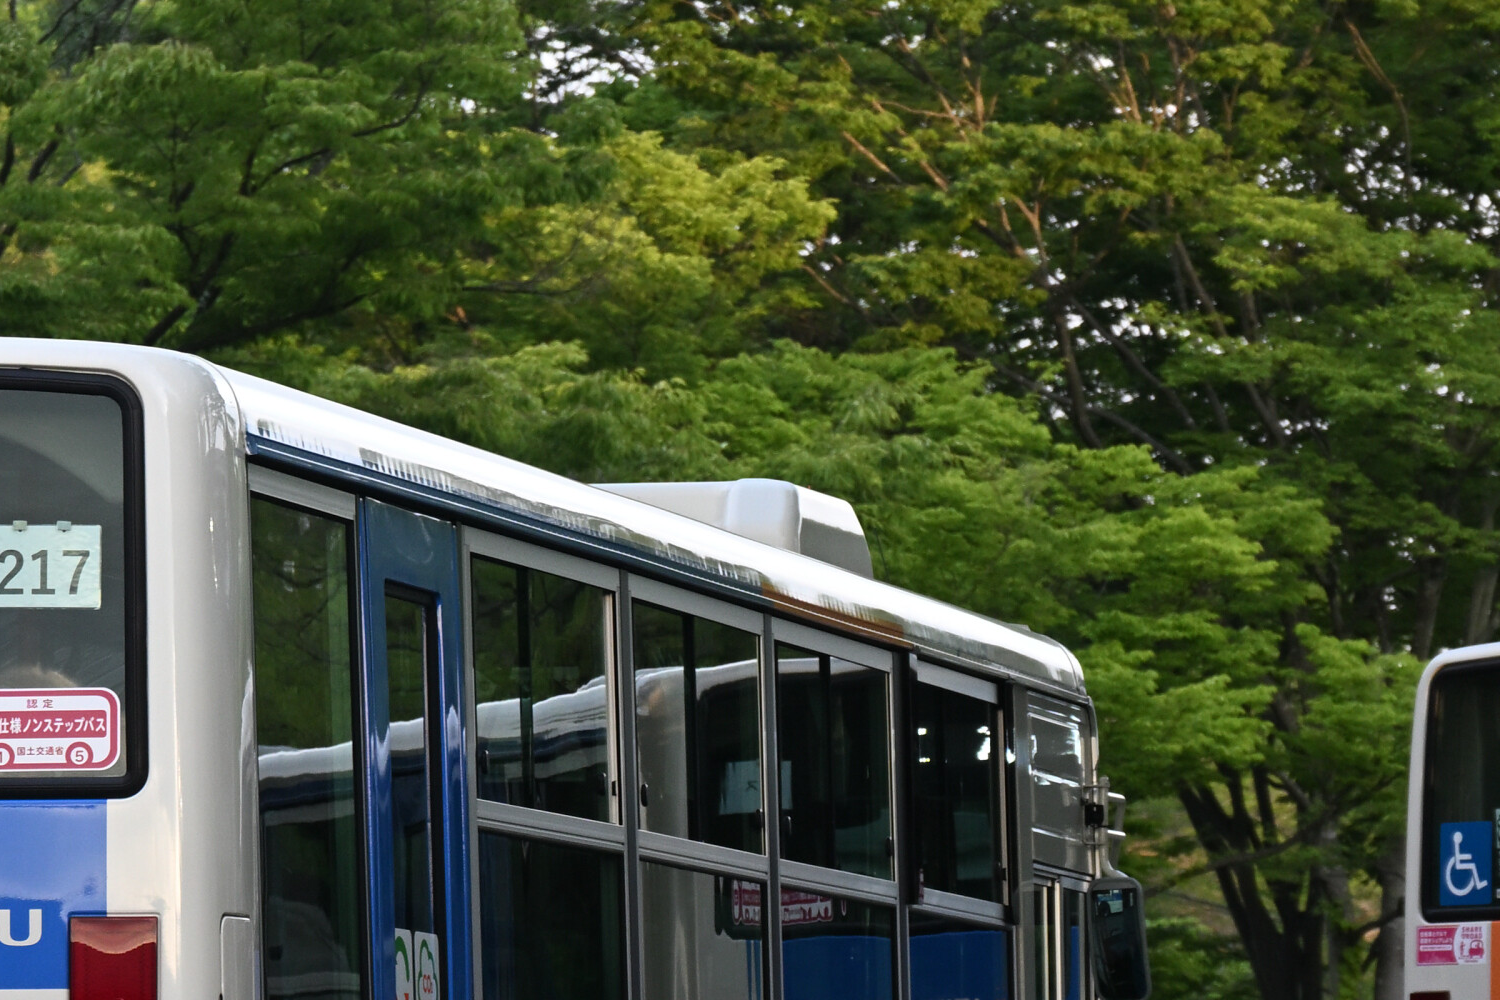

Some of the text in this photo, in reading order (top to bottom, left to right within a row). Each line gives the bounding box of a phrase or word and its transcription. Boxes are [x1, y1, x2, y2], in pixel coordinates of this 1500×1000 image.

[26, 698, 54, 709] 認定
[16, 746, 64, 756] 国土交通省
[75, 750, 84, 763] 5
